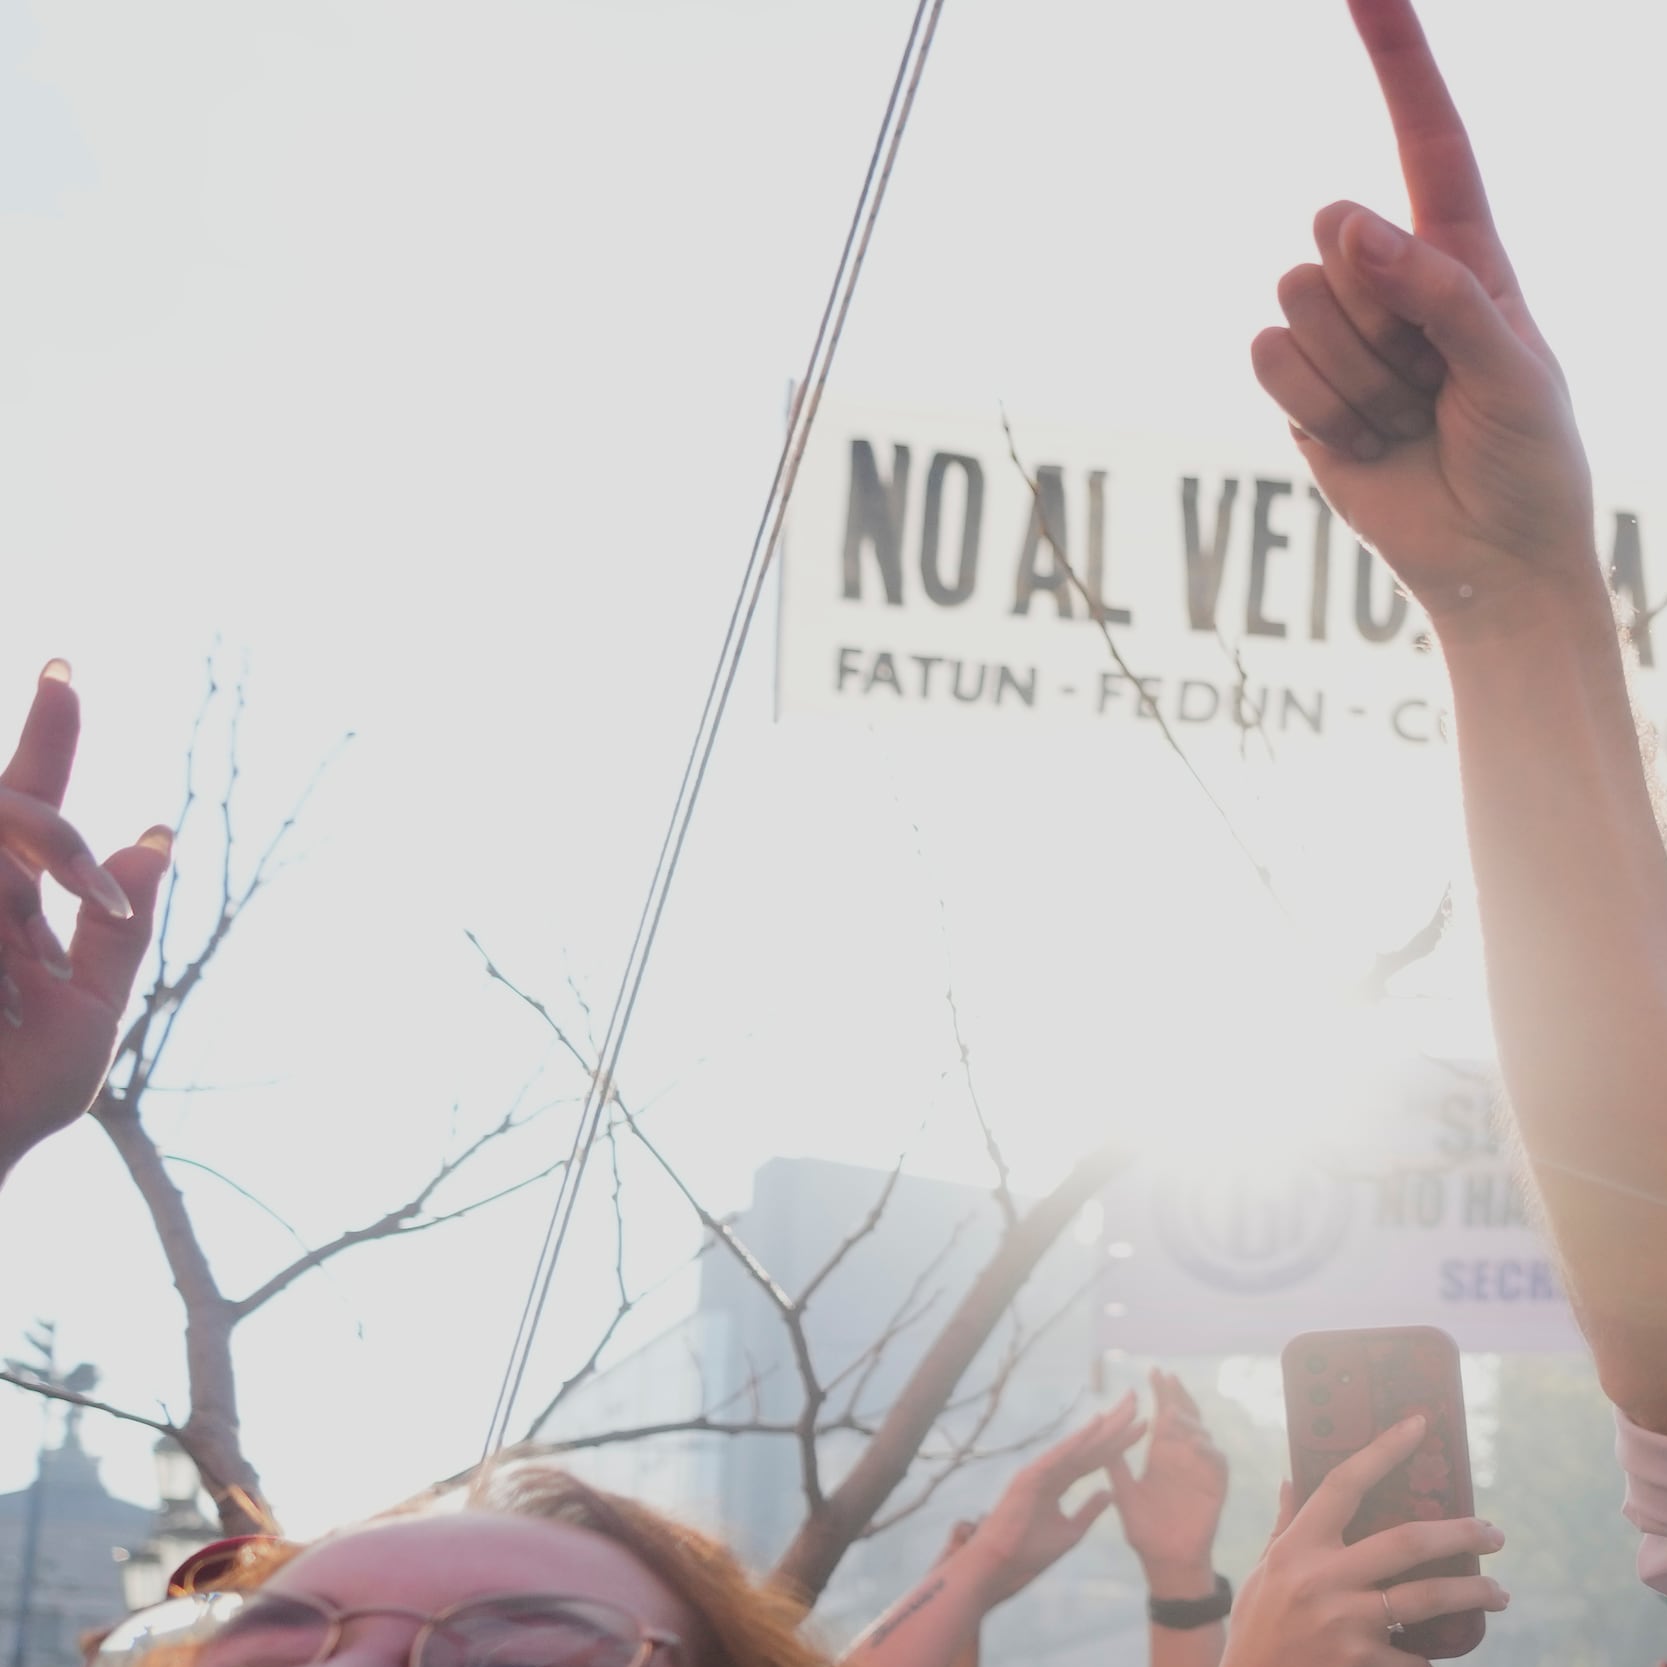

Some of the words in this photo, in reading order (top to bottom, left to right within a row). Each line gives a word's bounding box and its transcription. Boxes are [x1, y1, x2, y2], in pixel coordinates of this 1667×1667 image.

[842, 438, 984, 608] NO
[1012, 463, 1132, 625] AL
[836, 648, 1038, 708] FATUN
[1097, 671, 1324, 735] FEDUN
